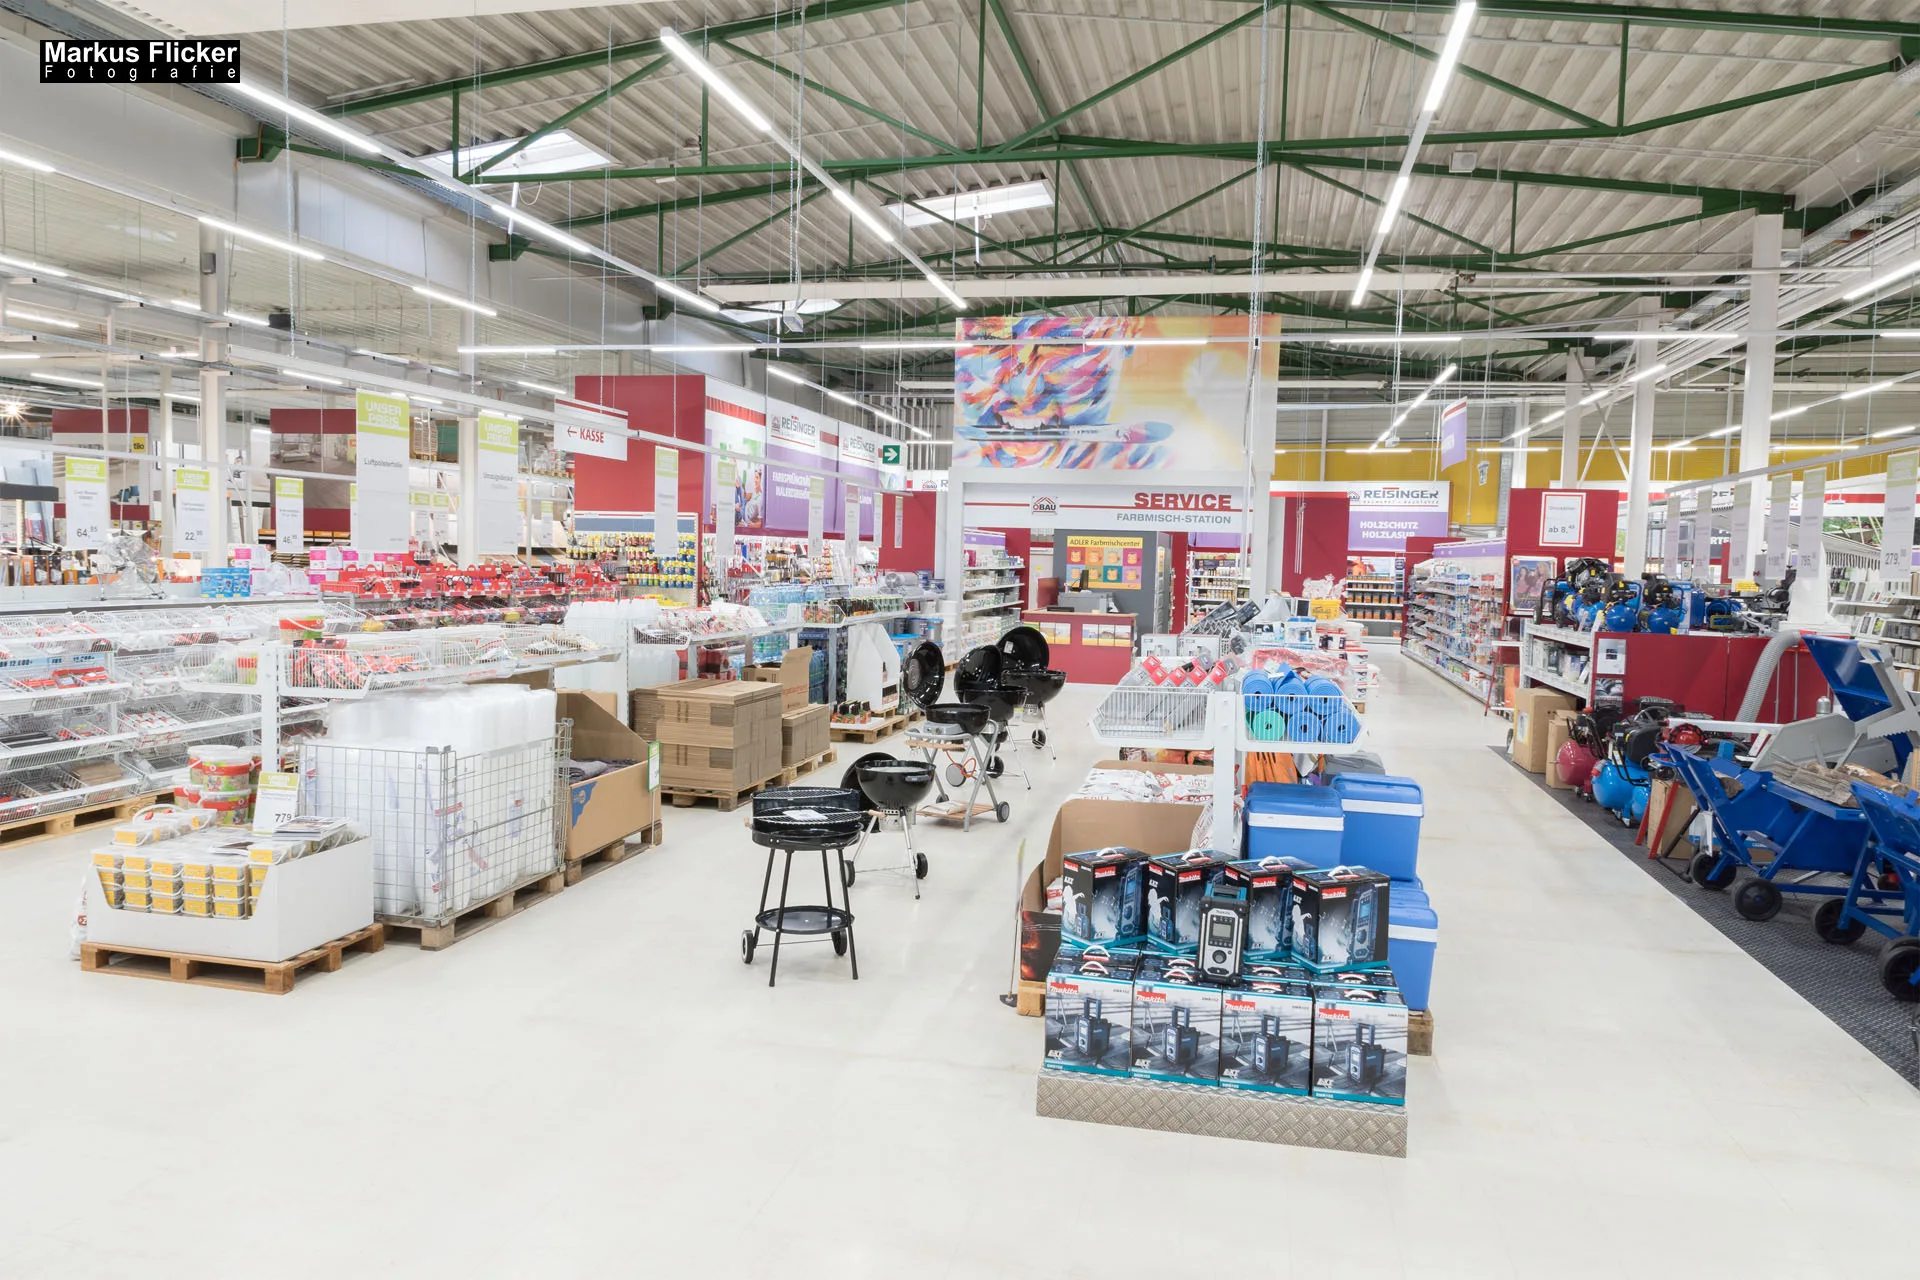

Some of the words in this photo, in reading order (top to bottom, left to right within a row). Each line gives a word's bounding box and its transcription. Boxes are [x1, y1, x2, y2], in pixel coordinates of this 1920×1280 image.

[365, 401, 402, 416] UNSER
[368, 413, 399, 429] PREIS
[782, 417, 815, 436] REISINGER
[580, 427, 604, 443] KASSE
[1364, 490, 1439, 499] REISINGER
[1135, 493, 1231, 510] SERVICE
[1117, 513, 1231, 524] FARBMISCH-STATION
[1360, 521, 1418, 529] HOLZSCHUTZ
[1362, 531, 1415, 539] HOLZLASUR
[1069, 538, 1089, 546] ADLER
[1090, 539, 1141, 548] Farbmischcenter
